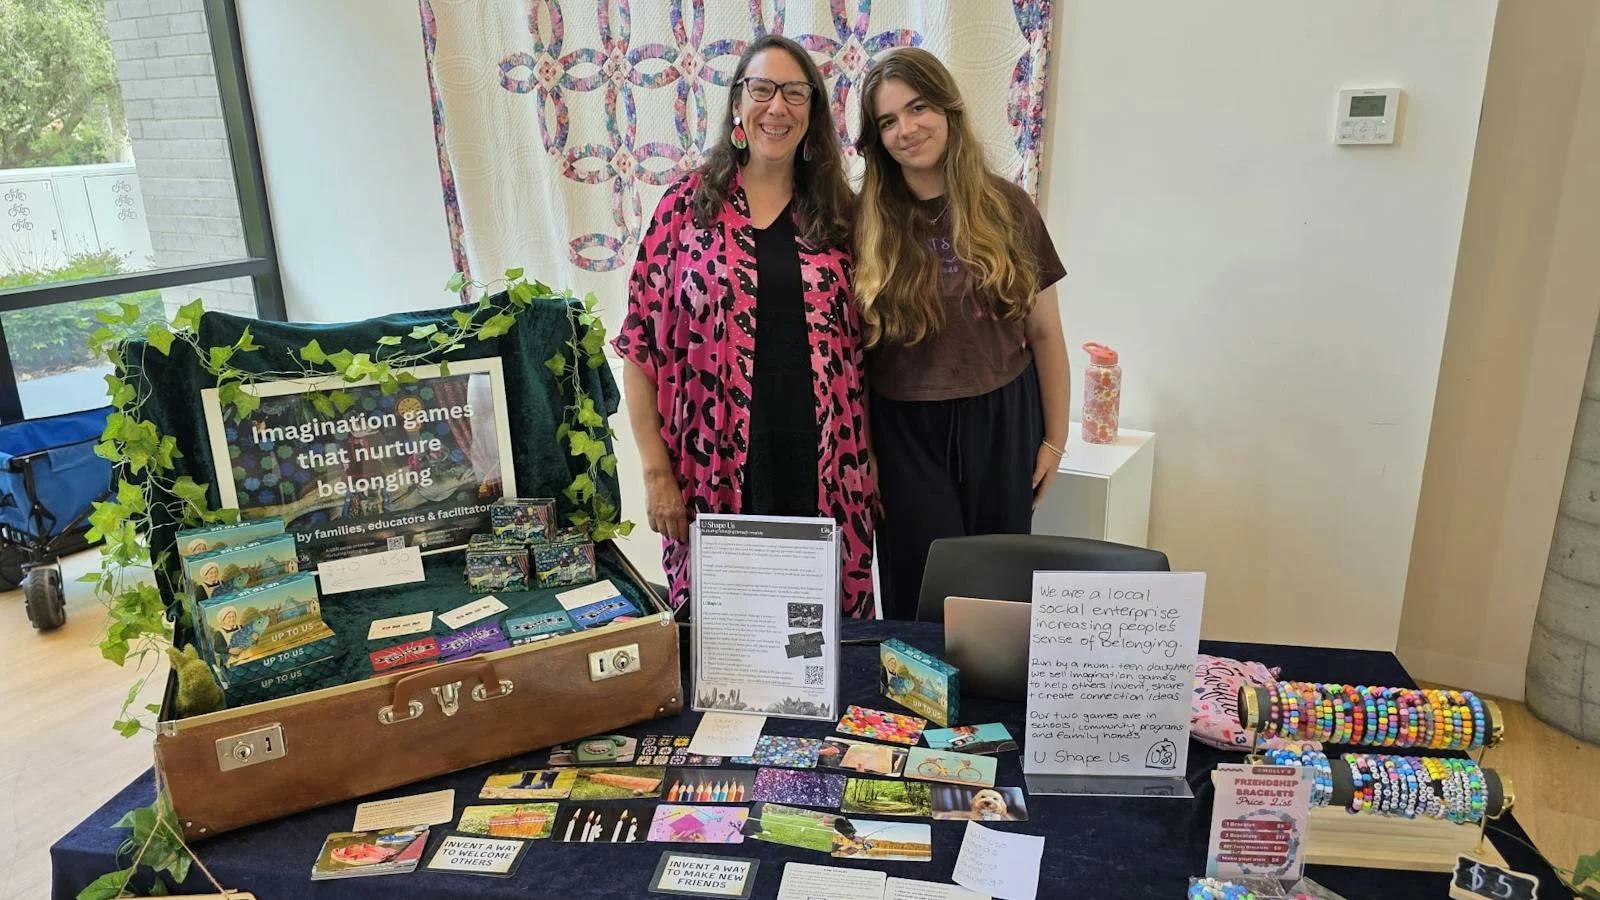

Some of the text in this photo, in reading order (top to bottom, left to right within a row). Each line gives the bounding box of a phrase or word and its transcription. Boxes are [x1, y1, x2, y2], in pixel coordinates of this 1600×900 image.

[252, 402, 474, 444] Imagination games
[297, 436, 442, 470] that nurture
[317, 466, 433, 498] belonging
[296, 503, 493, 543] by families, educators & facilitator
[707, 521, 726, 530] Shape
[1040, 584, 1150, 602] We are a local
[1039, 602, 1181, 621] social enterprise
[271, 622, 314, 642] UP TO US
[1036, 619, 1112, 641] increasing
[1081, 634, 1095, 651] of
[263, 647, 305, 667] UP TO US
[1031, 657, 1051, 667] Run
[1056, 659, 1068, 670] by
[1118, 663, 1144, 671] teen
[261, 669, 303, 688] UP TO US
[1049, 670, 1067, 678] sell
[1069, 670, 1134, 683] imagination
[1138, 673, 1177, 684] games
[1028, 680, 1185, 692] to help others invent, share
[1038, 692, 1074, 700] create
[1080, 691, 1144, 701] connection
[1148, 692, 1180, 701] ideas
[912, 699, 943, 718] UP TO US
[1030, 711, 1157, 723] Our two games are in
[1078, 722, 1136, 732] community
[1140, 723, 1184, 734] programs
[1031, 731, 1141, 744] and family homes
[1233, 730, 1247, 744] 13
[1034, 749, 1131, 767] U Shape Us
[1234, 778, 1299, 788] FRIENDSHIP
[1236, 788, 1295, 798] BRACELETS
[1235, 796, 1292, 807] Price List
[444, 841, 485, 850] INVENT
[495, 844, 519, 852] WAY
[442, 848, 512, 860] TO WELCOME
[450, 857, 493, 867] OTHERS
[669, 860, 711, 870] INVENT
[723, 865, 747, 873] WAY
[667, 868, 744, 881] TO MAKE NEW
[1467, 862, 1513, 899] $5
[677, 878, 727, 888] FRIENDS
